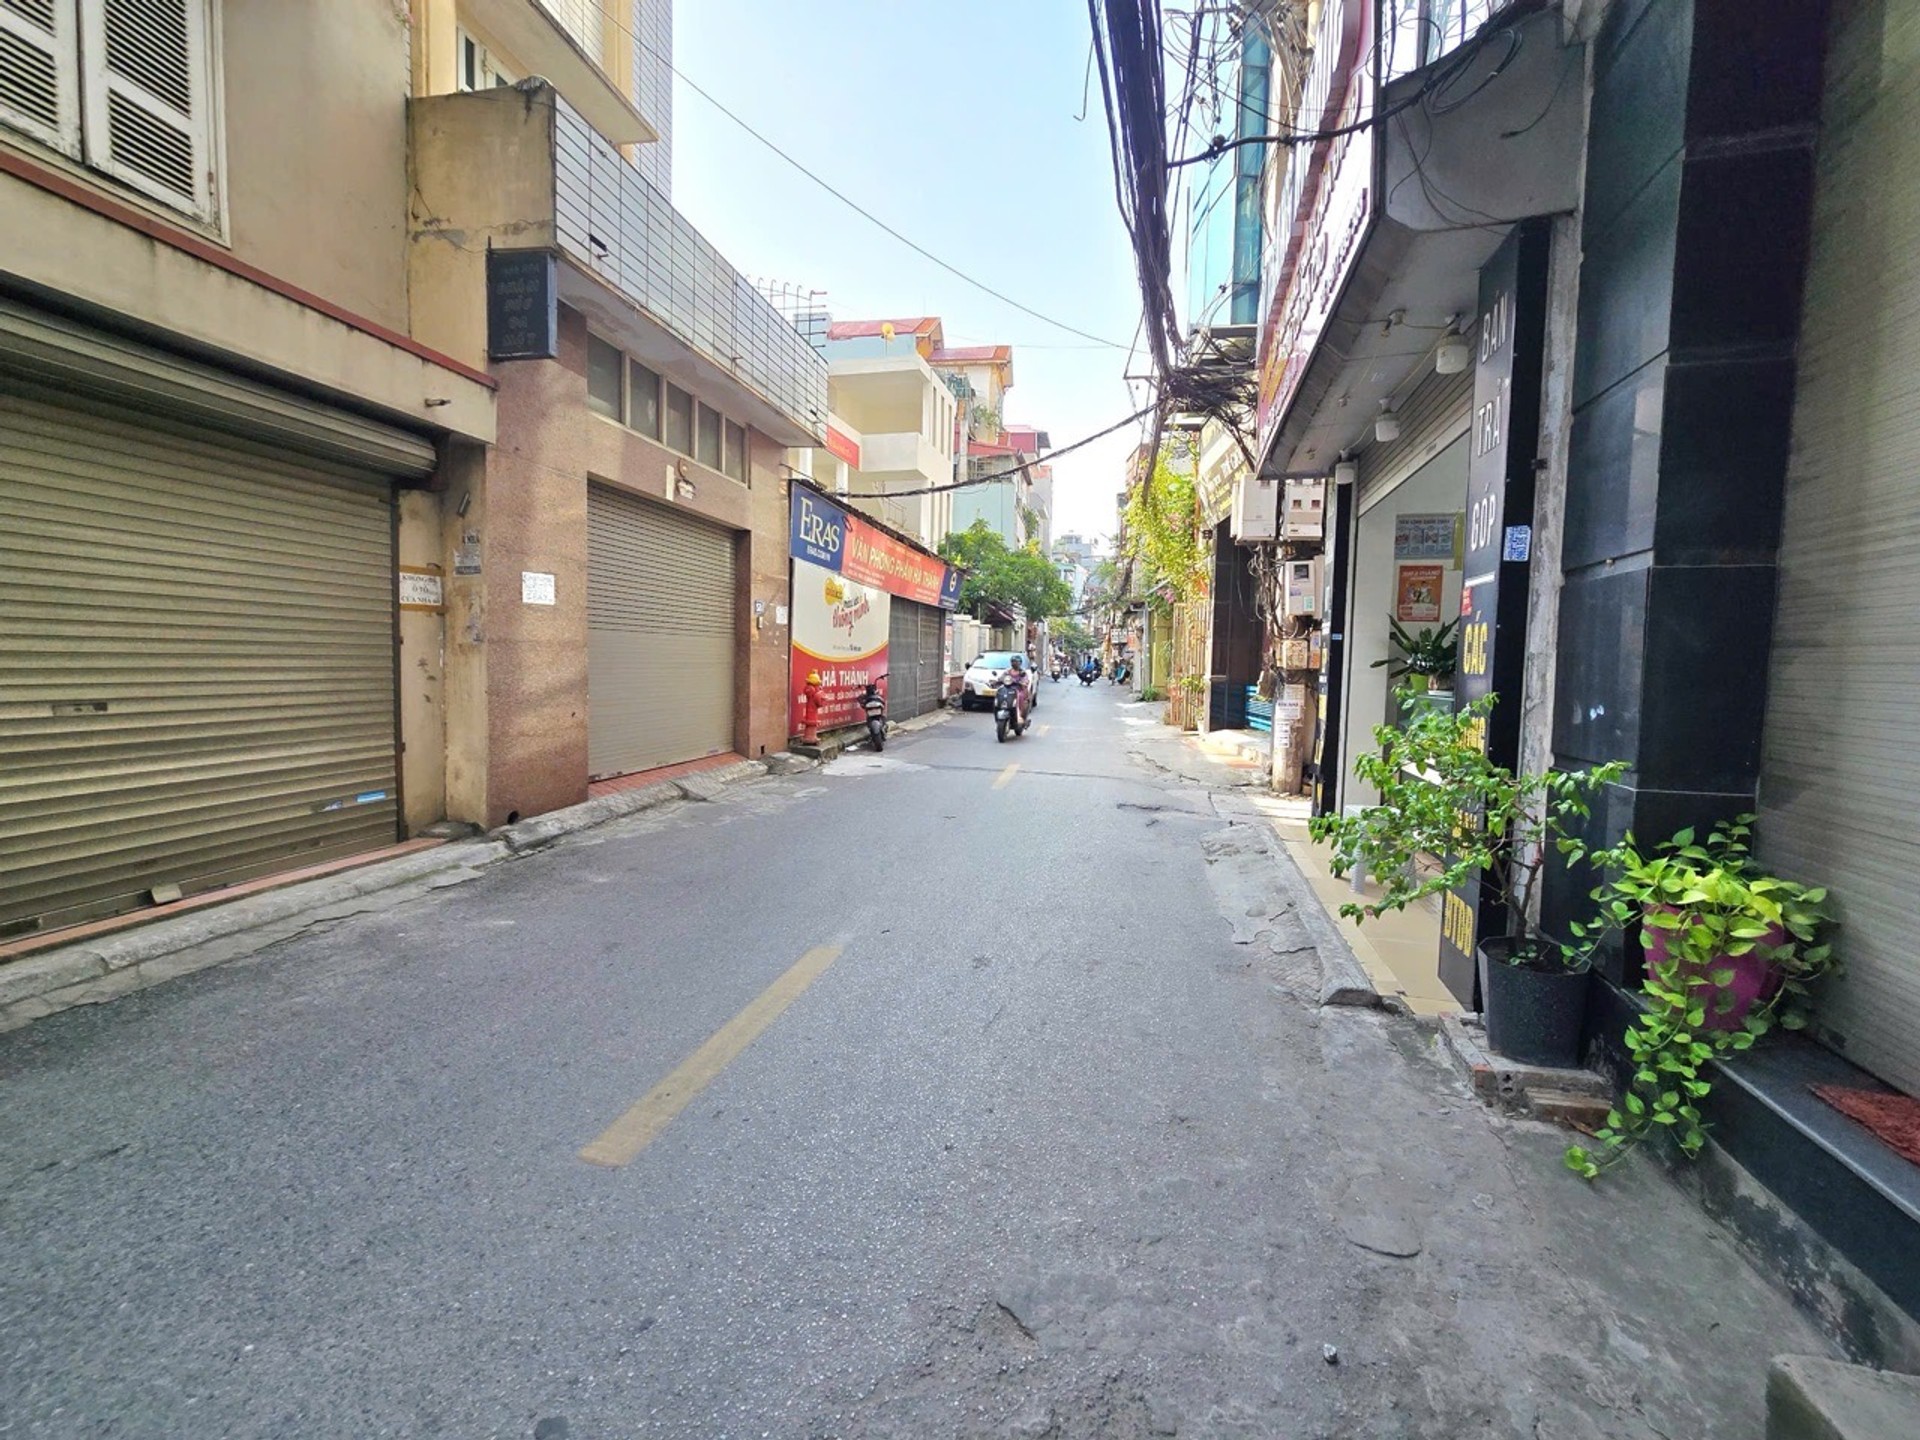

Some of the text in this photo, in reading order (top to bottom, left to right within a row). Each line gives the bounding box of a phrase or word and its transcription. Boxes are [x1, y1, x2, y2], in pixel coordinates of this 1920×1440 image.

[1482, 289, 1508, 364] BÁN
[799, 496, 841, 553] ERAS
[1471, 483, 1496, 552] GÓP
[1463, 610, 1488, 674] CÁC
[821, 665, 869, 687] HÀ THÀNH
